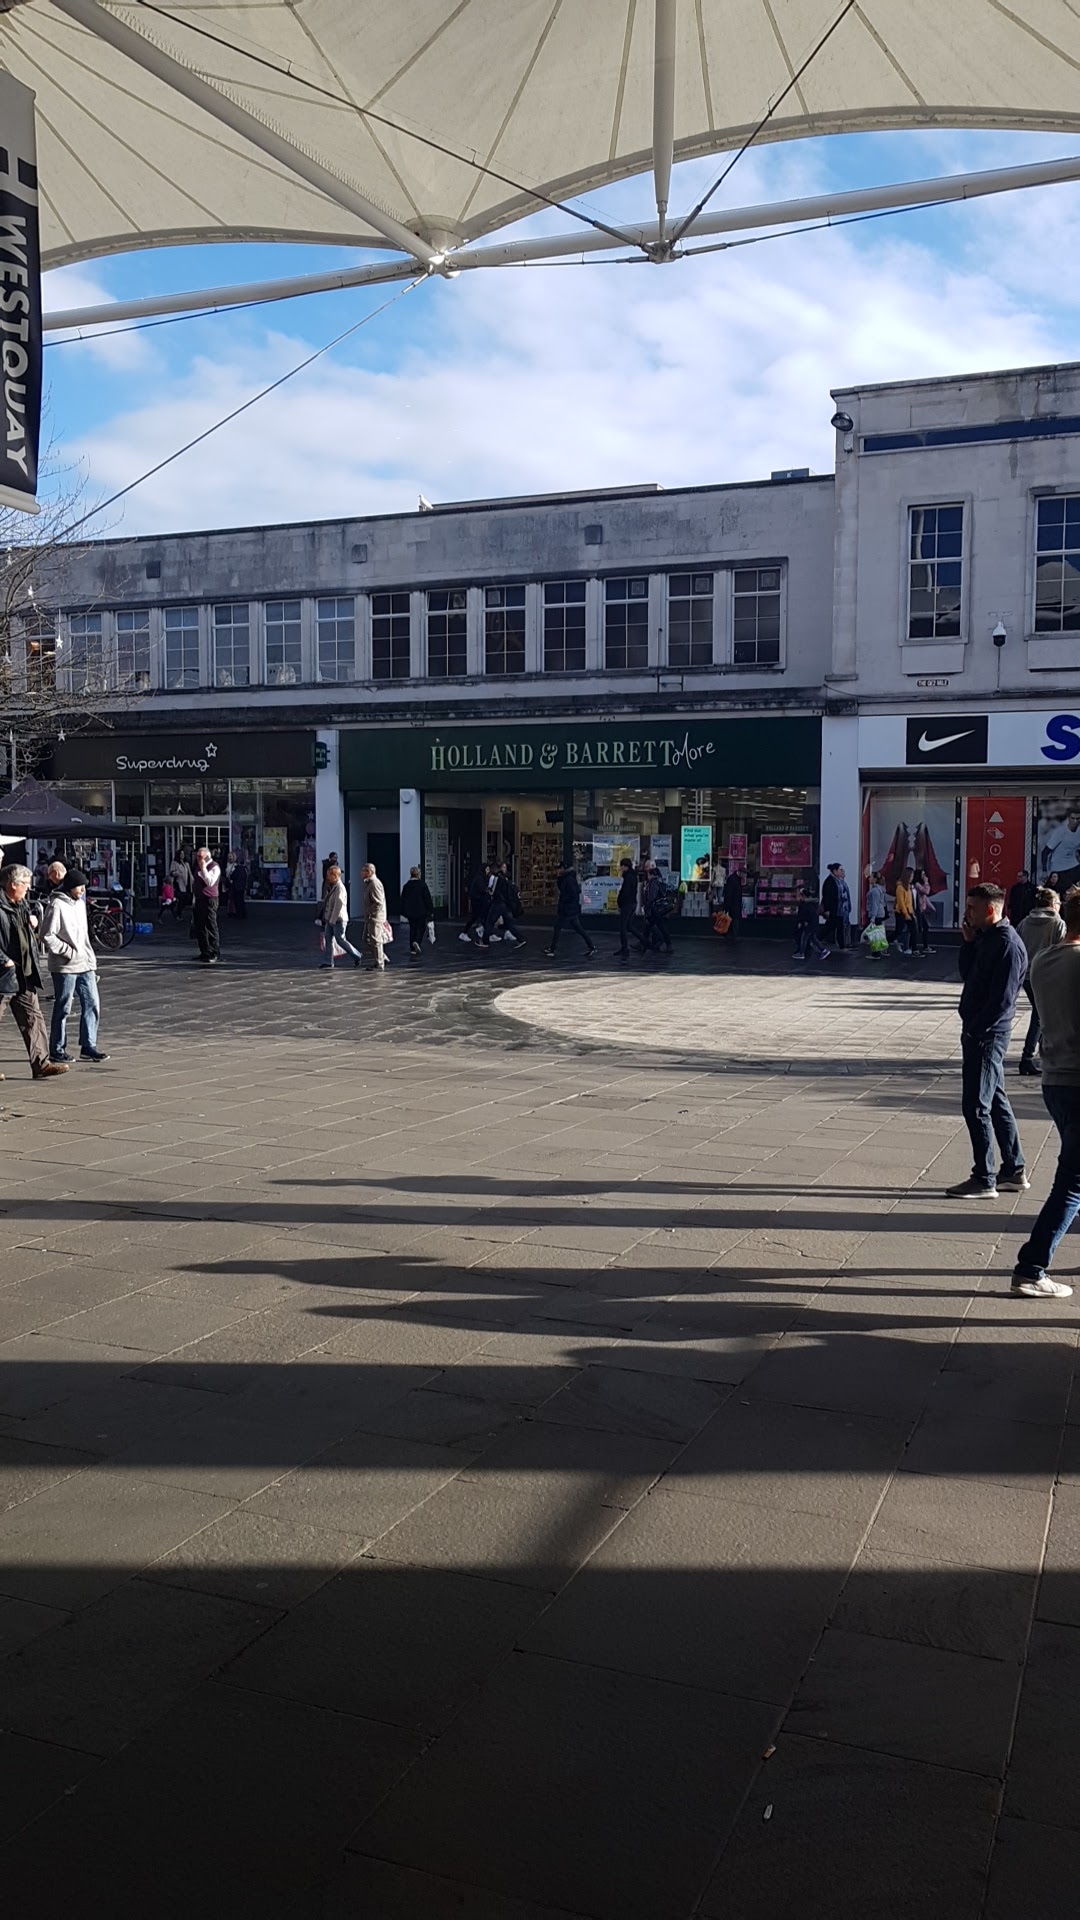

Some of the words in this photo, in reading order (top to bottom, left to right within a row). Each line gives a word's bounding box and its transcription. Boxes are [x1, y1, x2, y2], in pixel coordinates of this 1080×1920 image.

[0, 215, 30, 477] WESTQUAY
[430, 744, 534, 771] HOLLAND
[540, 742, 559, 769] &
[566, 740, 675, 767] BARRETT
[672, 732, 716, 769] More
[1040, 714, 1080, 761] S
[116, 756, 210, 773] Superdrug
